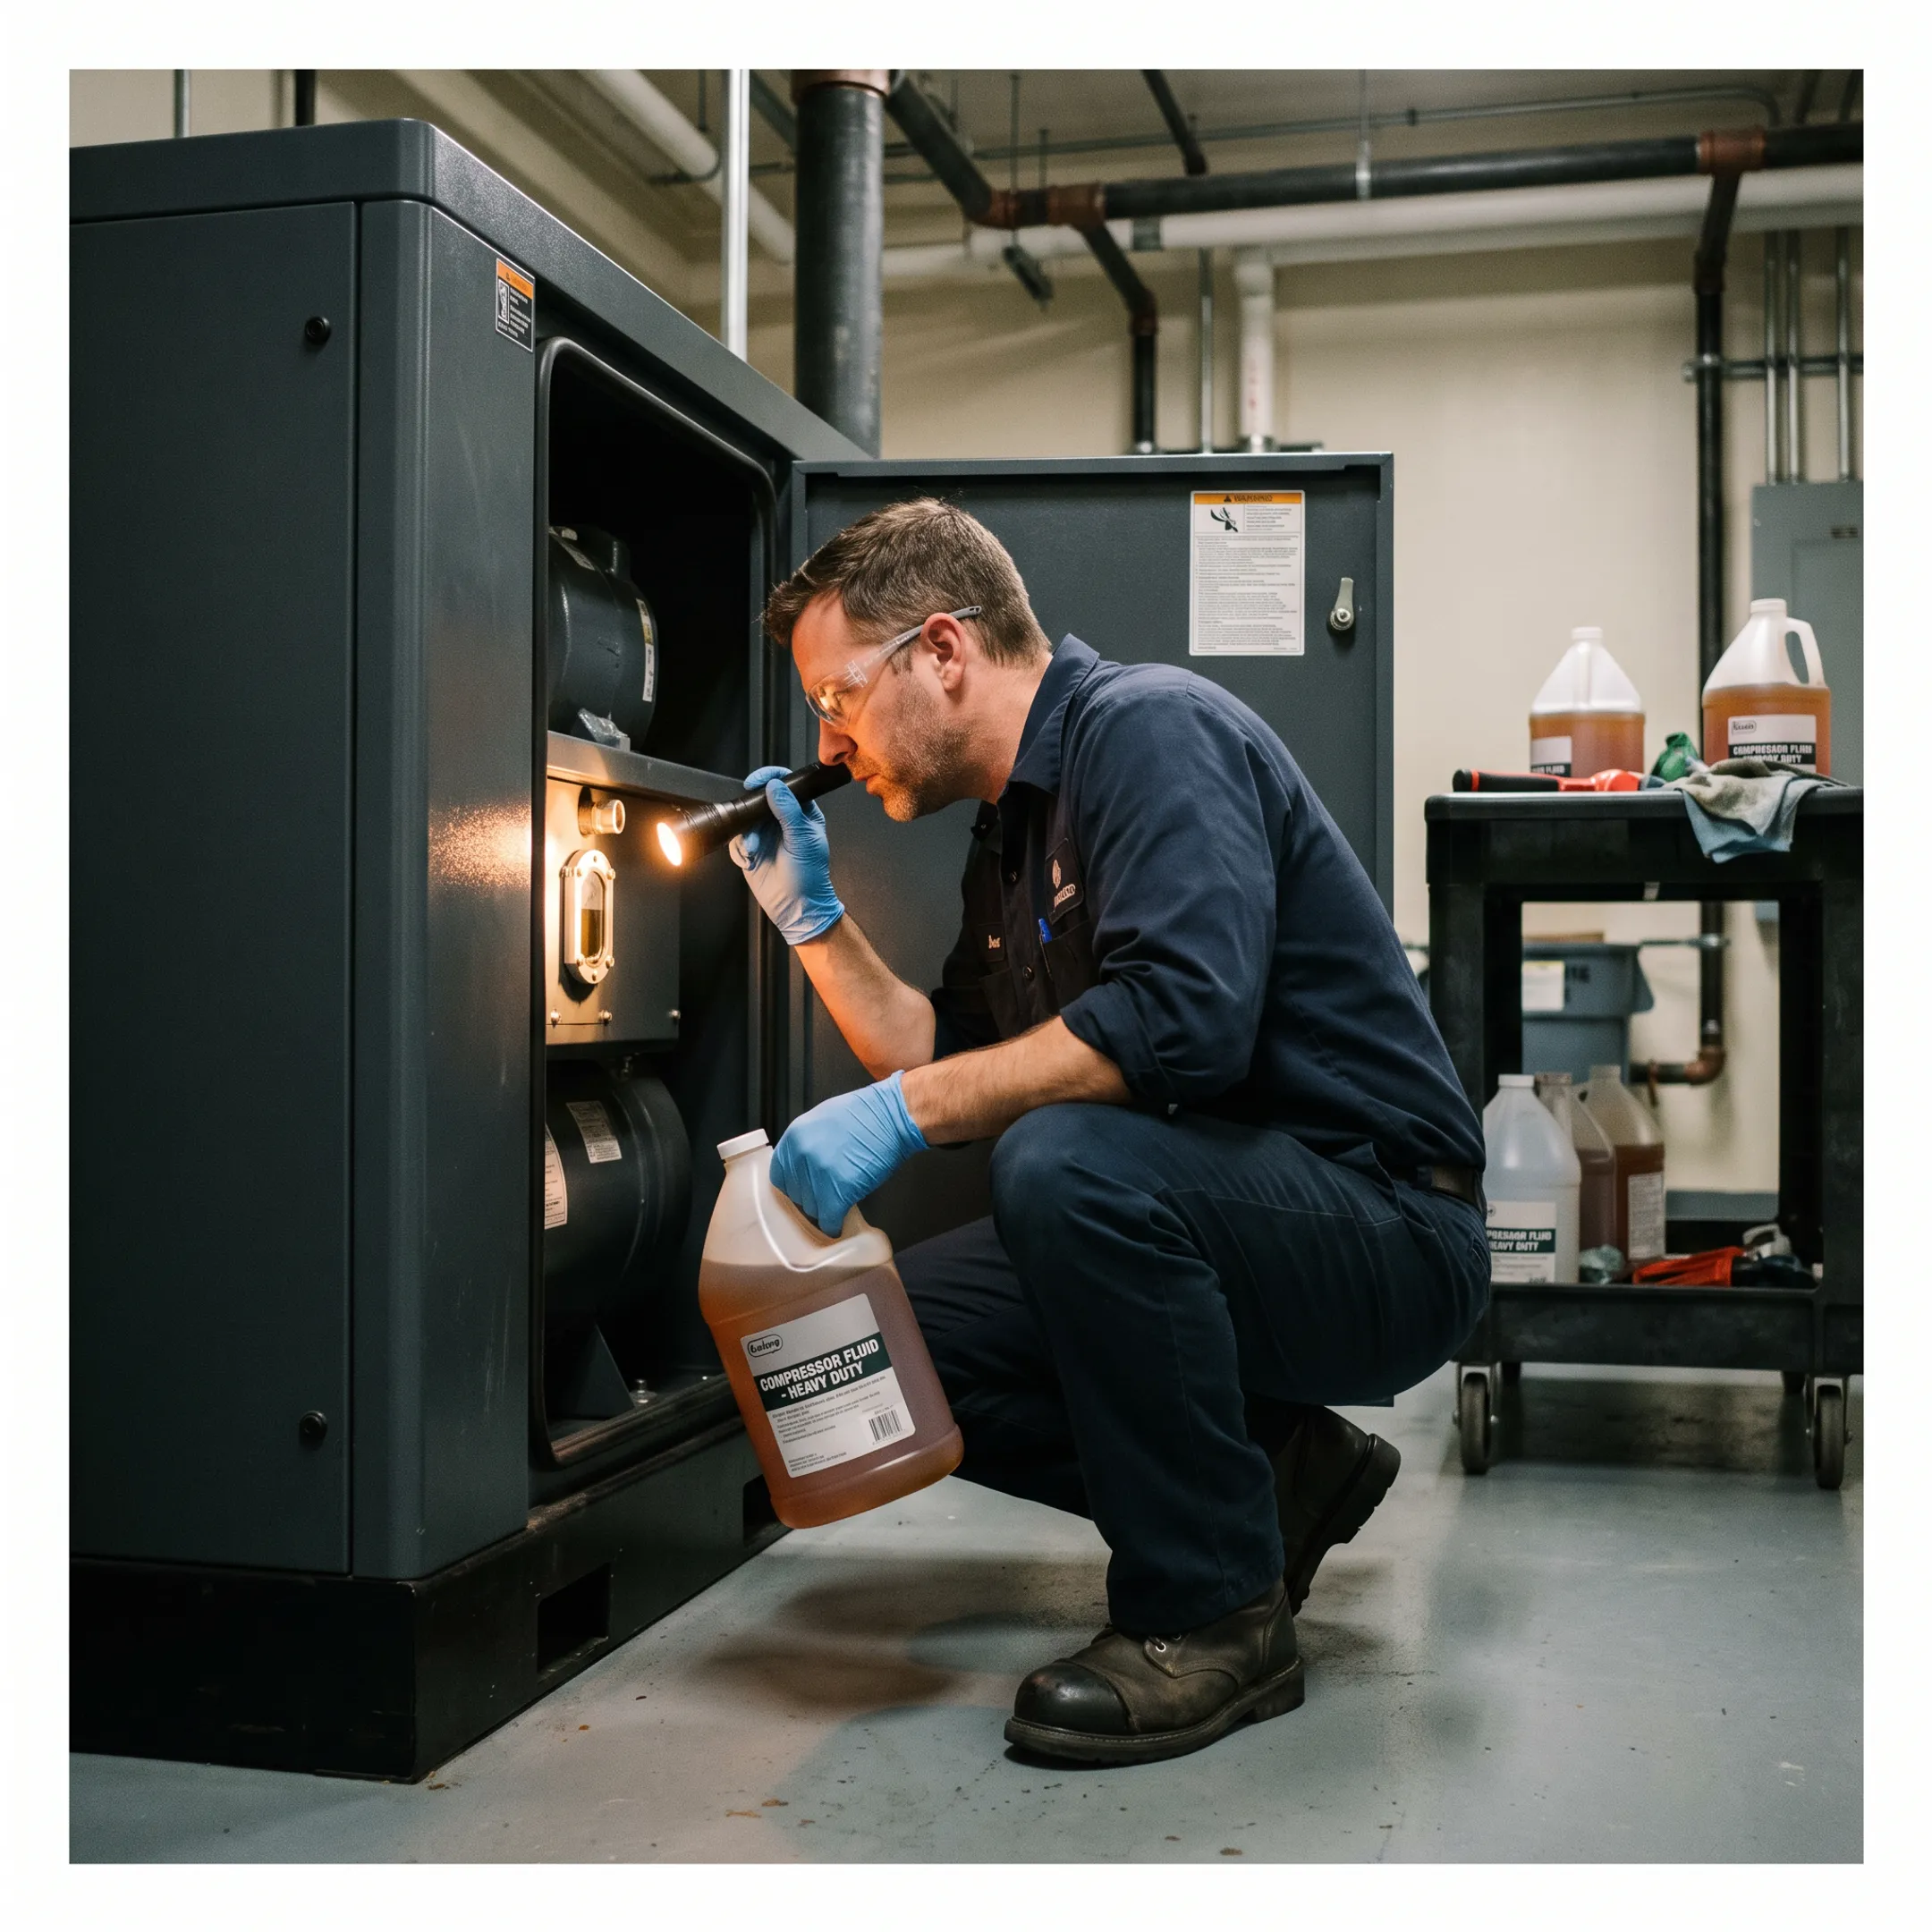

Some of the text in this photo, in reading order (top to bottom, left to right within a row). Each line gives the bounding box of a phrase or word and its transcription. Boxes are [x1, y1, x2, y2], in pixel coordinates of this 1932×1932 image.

[760, 1354, 843, 1391] COMPRESSOR
[843, 1338, 879, 1363] FLUID
[787, 1374, 827, 1400] HEAVY
[829, 1361, 864, 1385] DUTY
